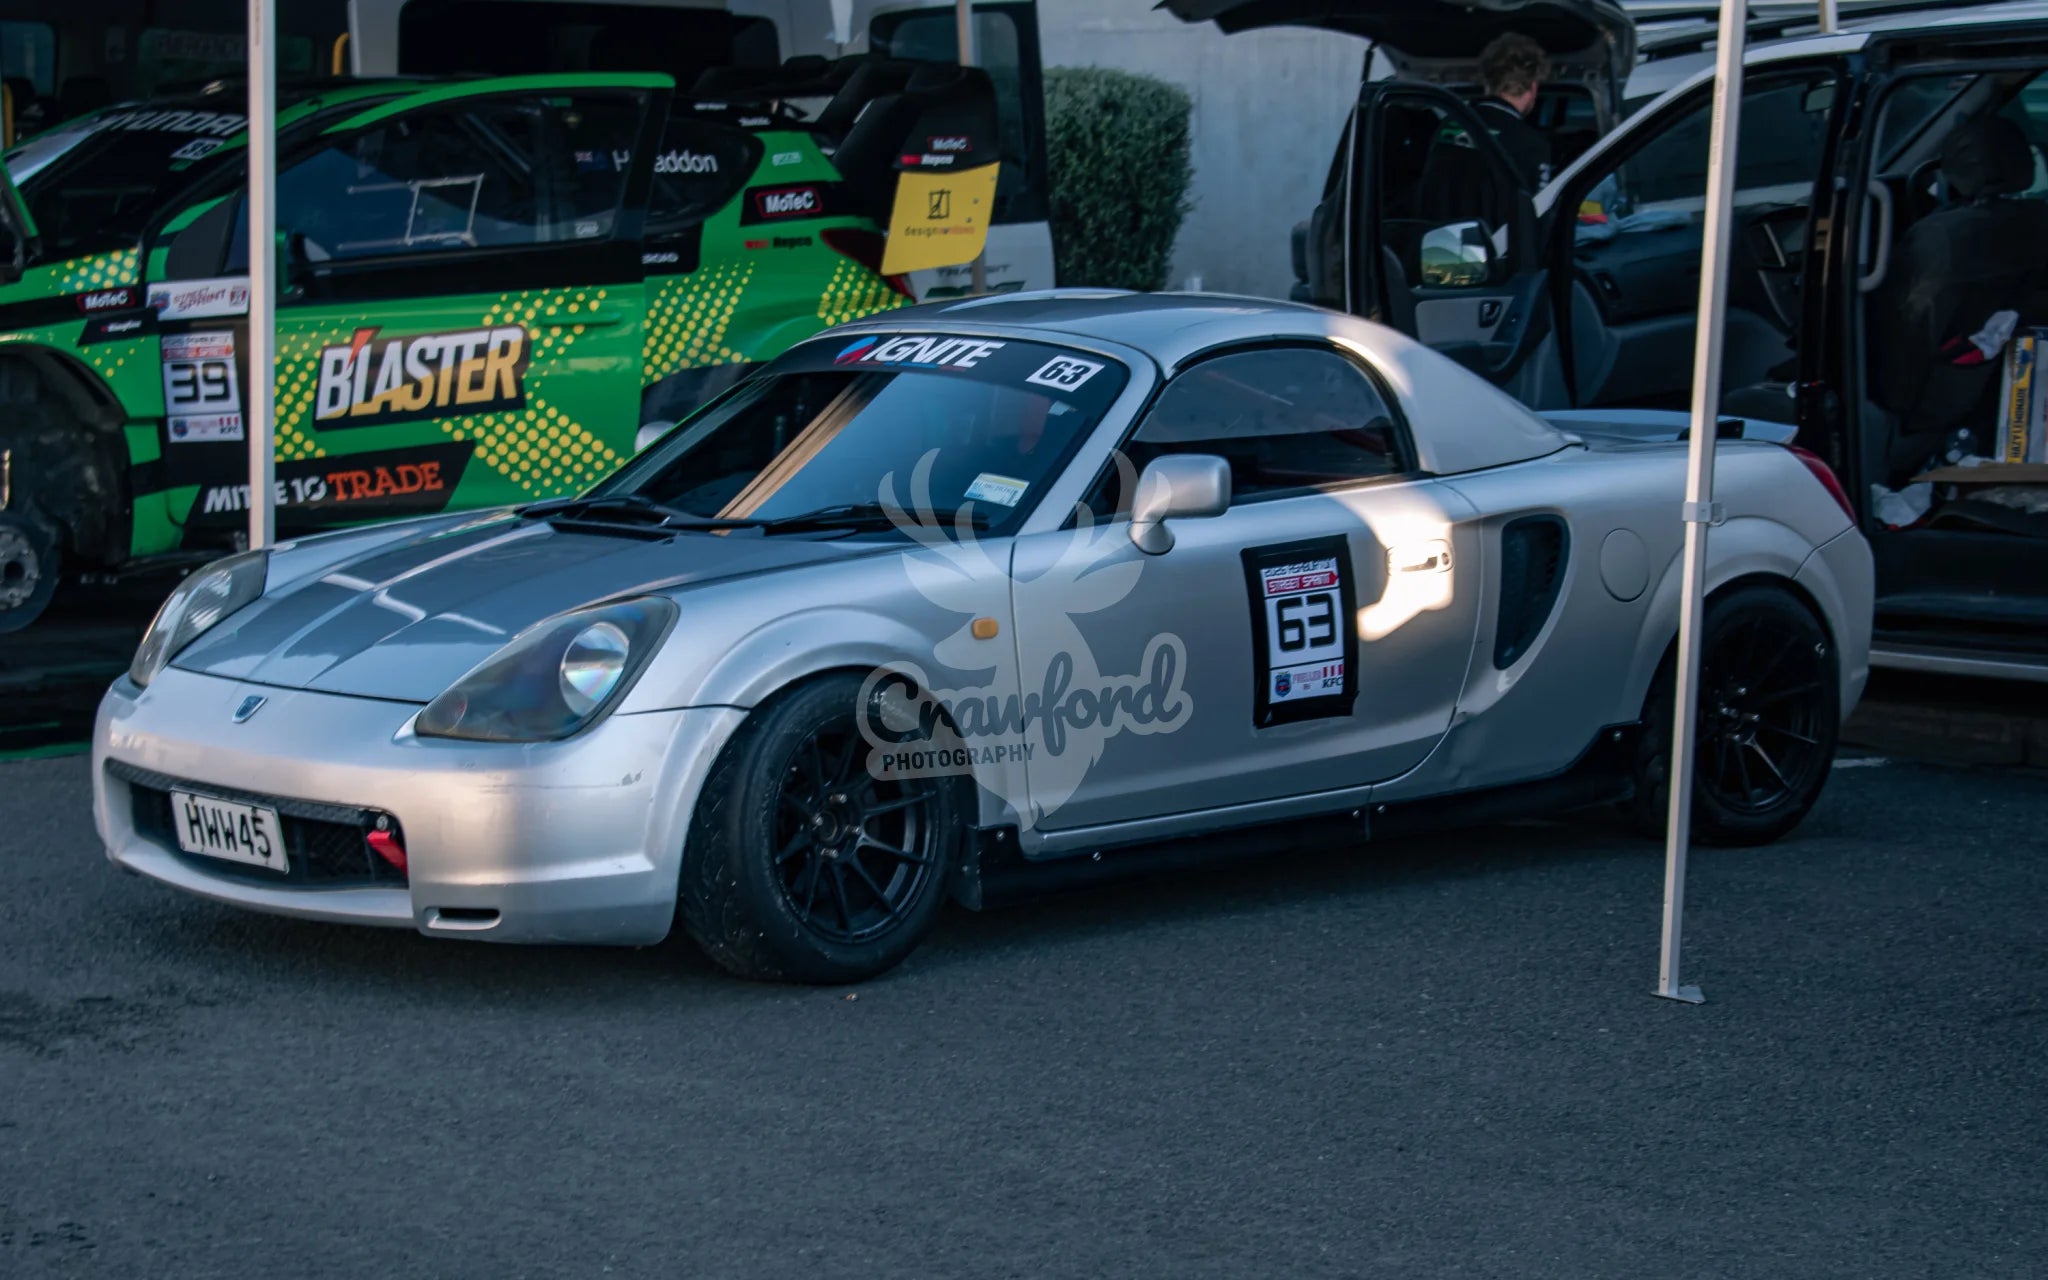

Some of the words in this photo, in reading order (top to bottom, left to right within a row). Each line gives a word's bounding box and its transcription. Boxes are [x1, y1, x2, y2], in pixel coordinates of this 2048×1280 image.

[654, 149, 719, 173] addon
[765, 189, 815, 214] MoTeC
[936, 264, 1010, 278] TRASIT
[860, 336, 1008, 369] IGNITE
[171, 362, 231, 404] 39
[315, 325, 525, 421] BLASTER
[1038, 359, 1092, 386] 63
[203, 480, 289, 513] MITE
[290, 475, 328, 503] 10
[327, 461, 444, 501] TRADE
[1268, 577, 1301, 593] STREET
[1302, 573, 1331, 588] SPRINT
[1276, 592, 1337, 653] 63
[1321, 676, 1344, 689] KFC
[184, 802, 272, 859] HWW45
